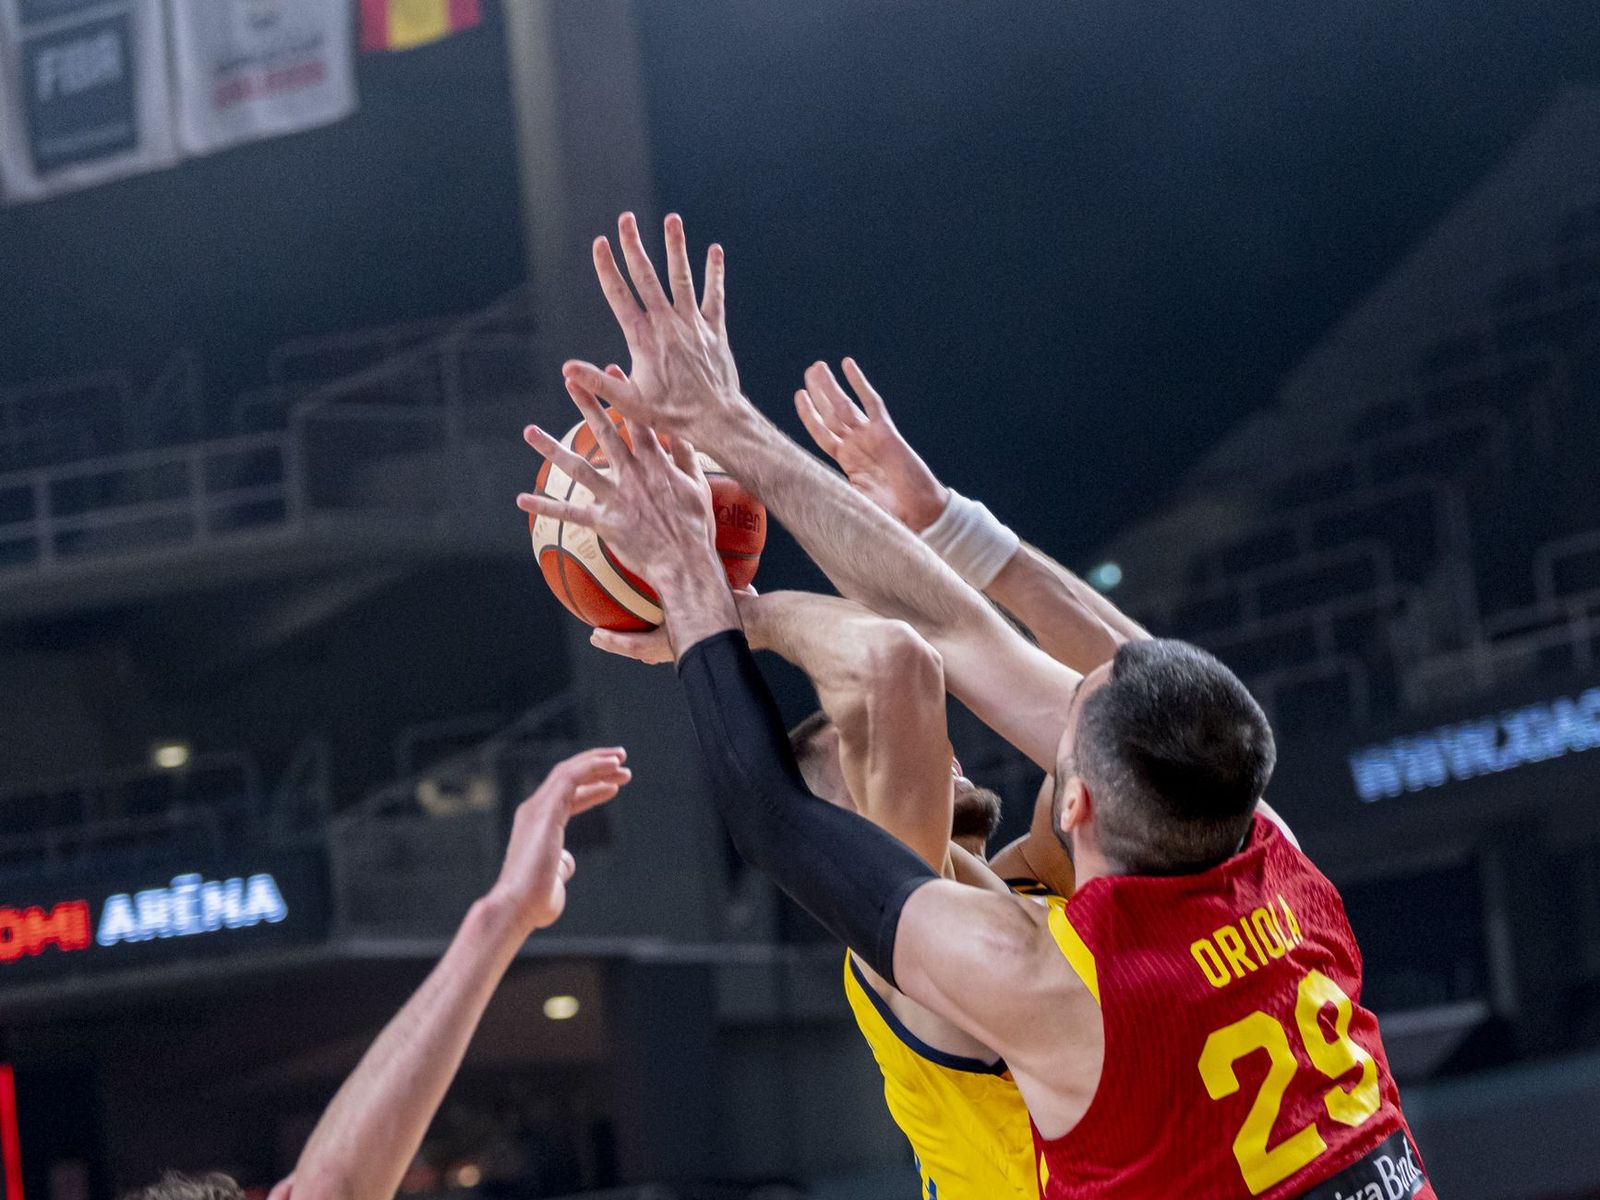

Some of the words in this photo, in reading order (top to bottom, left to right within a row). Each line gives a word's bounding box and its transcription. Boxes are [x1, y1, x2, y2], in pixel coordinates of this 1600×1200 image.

[713, 503, 761, 534] olten
[1190, 894, 1303, 988] ORIOLA
[1198, 968, 1381, 1196] 29
